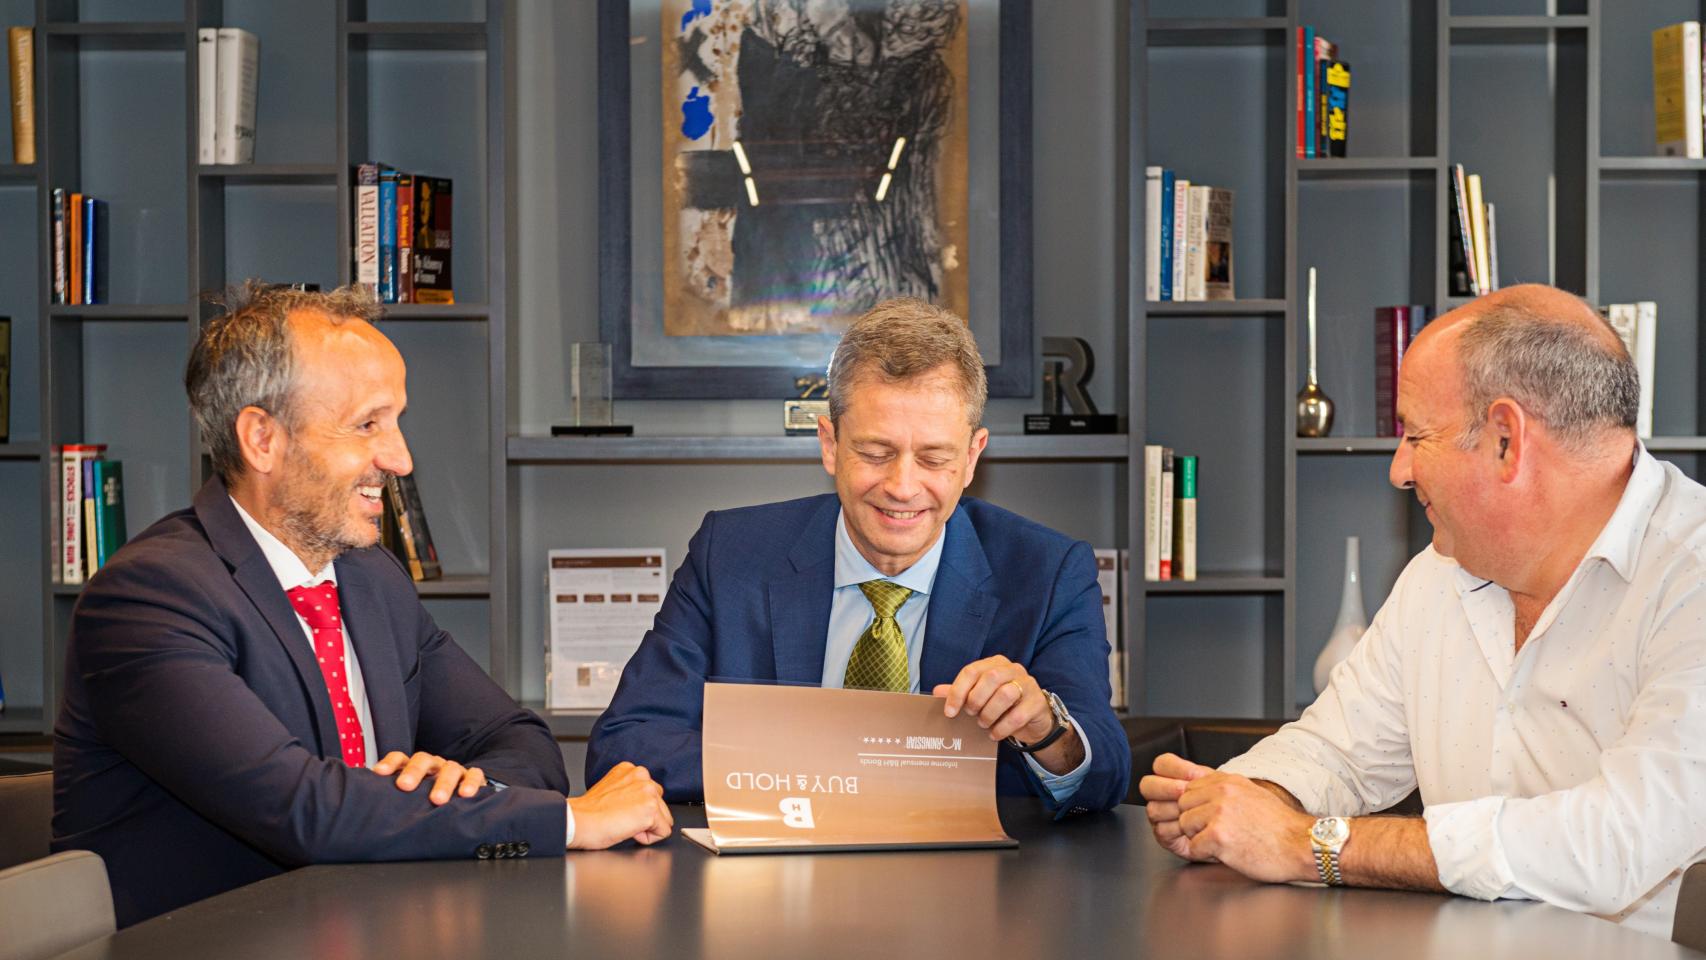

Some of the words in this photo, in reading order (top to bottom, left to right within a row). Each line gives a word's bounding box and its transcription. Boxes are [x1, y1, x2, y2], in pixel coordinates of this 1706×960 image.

[361, 190, 376, 265] VALUATION
[67, 465, 75, 502] STOCKS
[67, 516, 75, 541] LONG
[906, 736, 962, 751] MORNINGSTAR
[901, 760, 930, 768] mensual
[931, 760, 958, 769] Informe
[726, 772, 790, 792] HOLD
[796, 775, 808, 790] &
[811, 775, 859, 794] BUY
